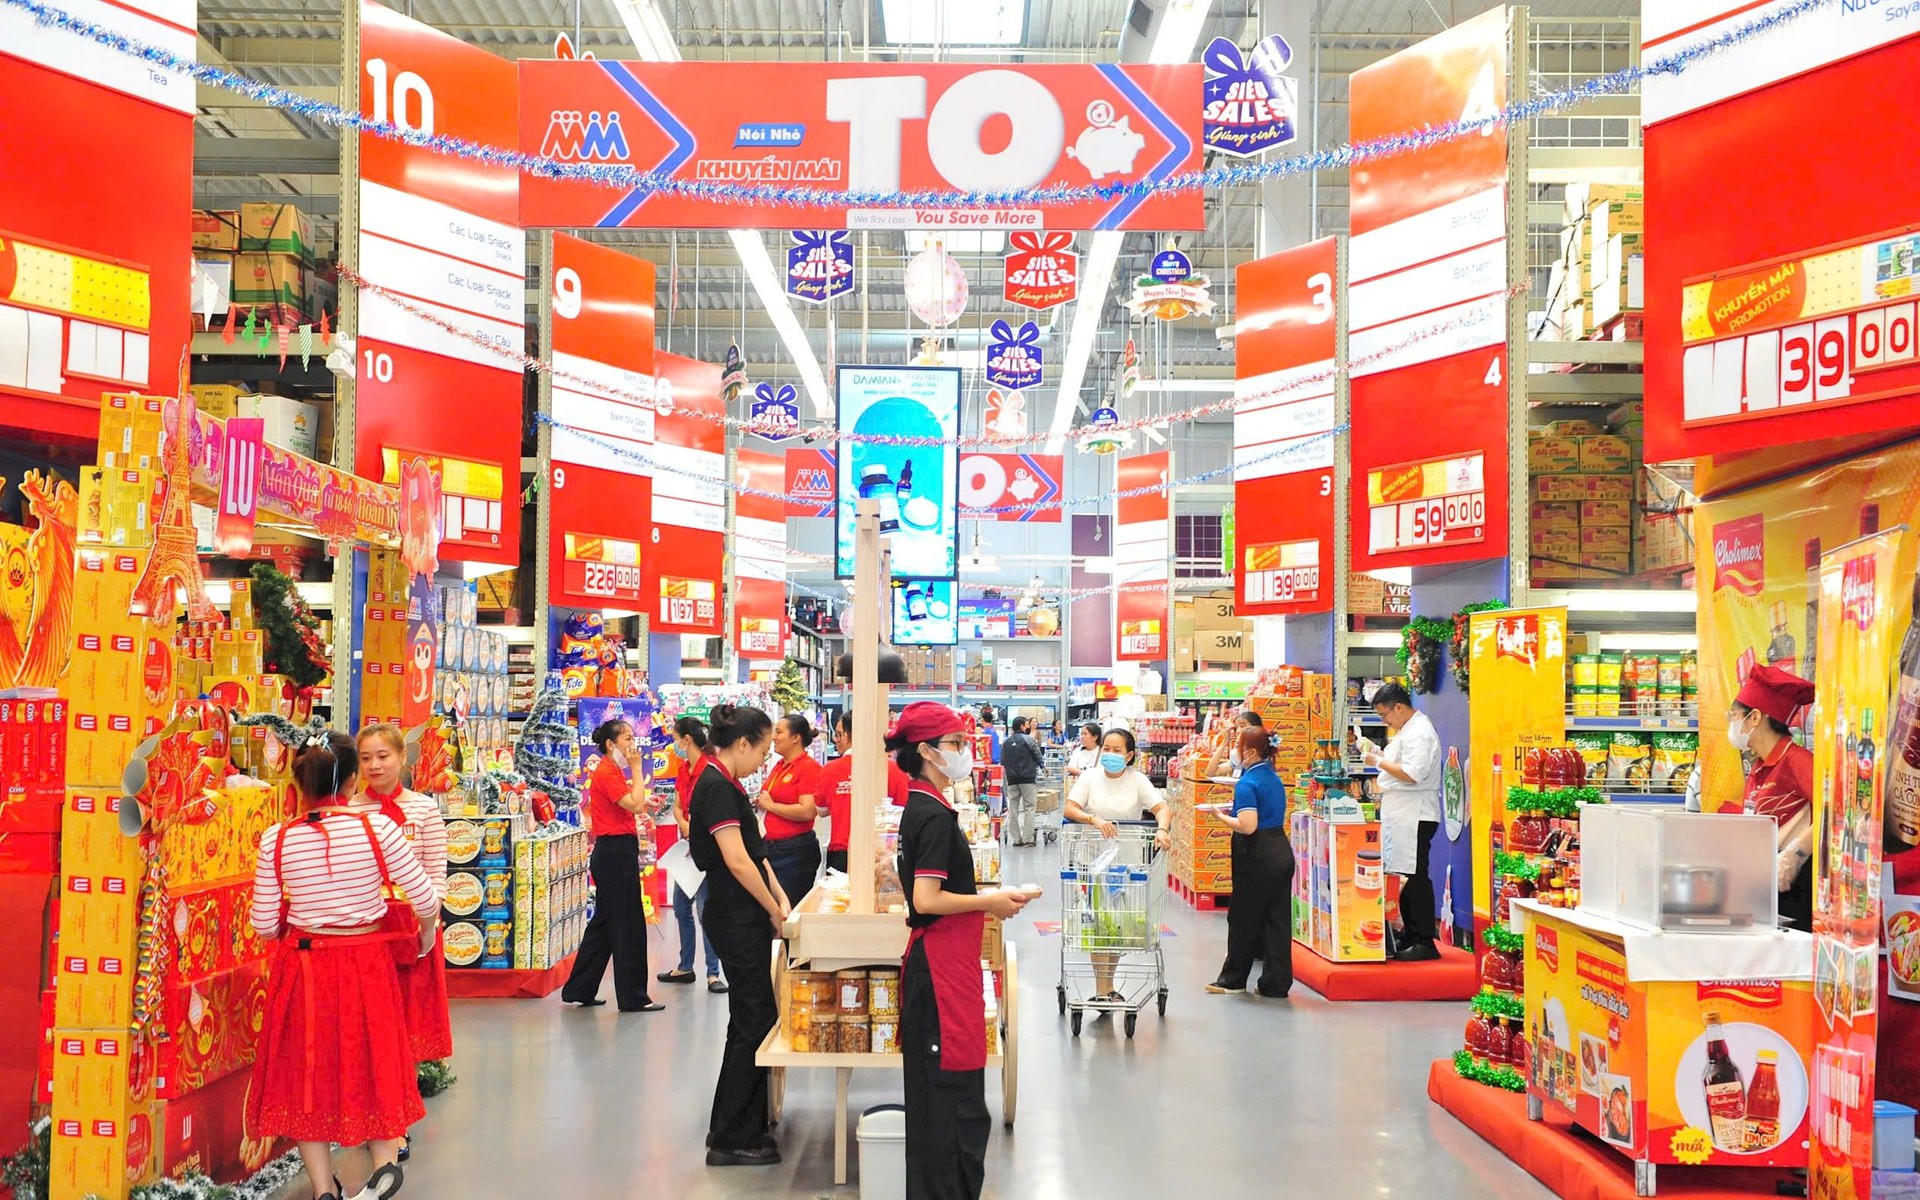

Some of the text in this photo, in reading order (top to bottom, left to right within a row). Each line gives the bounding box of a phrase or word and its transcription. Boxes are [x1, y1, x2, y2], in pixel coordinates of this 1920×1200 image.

[147, 68, 168, 86] Tea
[366, 58, 434, 143] 10
[1459, 61, 1500, 137] 4
[1203, 99, 1291, 123] SALES
[739, 127, 801, 141] Nói Nhỏ
[826, 70, 1065, 196] TO
[1210, 125, 1281, 146] Giáng sinh
[696, 156, 791, 181] KHUYẾN
[853, 211, 1036, 227] We Say Less You Save More
[488, 234, 512, 251] Snack
[789, 259, 852, 279] SALES
[1008, 267, 1075, 288] SALES
[487, 284, 511, 300] Snack
[555, 267, 582, 319] 9
[1143, 290, 1164, 298] Happy
[1181, 288, 1196, 297] Year
[1307, 272, 1332, 324] 3
[1713, 278, 1769, 323] KHUYẾN
[1729, 285, 1791, 331] PROMOTION
[364, 350, 393, 383] 10
[988, 356, 1041, 373] SALES
[1484, 357, 1501, 386] 4
[853, 375, 896, 384] DAMIAN
[655, 377, 673, 416] 8
[226, 437, 255, 516] LU
[264, 464, 291, 497] Món
[553, 468, 565, 488] 9
[738, 469, 750, 496] 7
[1160, 470, 1168, 498] 1
[1320, 475, 1331, 496] 3
[334, 492, 353, 514] 1846
[1413, 500, 1482, 538] 59 000
[652, 528, 660, 543] 8
[1714, 536, 1763, 567] Cholimex
[587, 567, 639, 592] 226 000
[736, 580, 742, 592] 7
[1275, 571, 1317, 596] 39 000
[673, 603, 713, 619] 197 000
[1215, 635, 1242, 648] 3M
[565, 678, 583, 689] Tide
[1575, 738, 1601, 750] Knorr
[1613, 734, 1641, 747] Knorr
[1659, 737, 1691, 750] Knorr
[1676, 1137, 1705, 1153] mới
